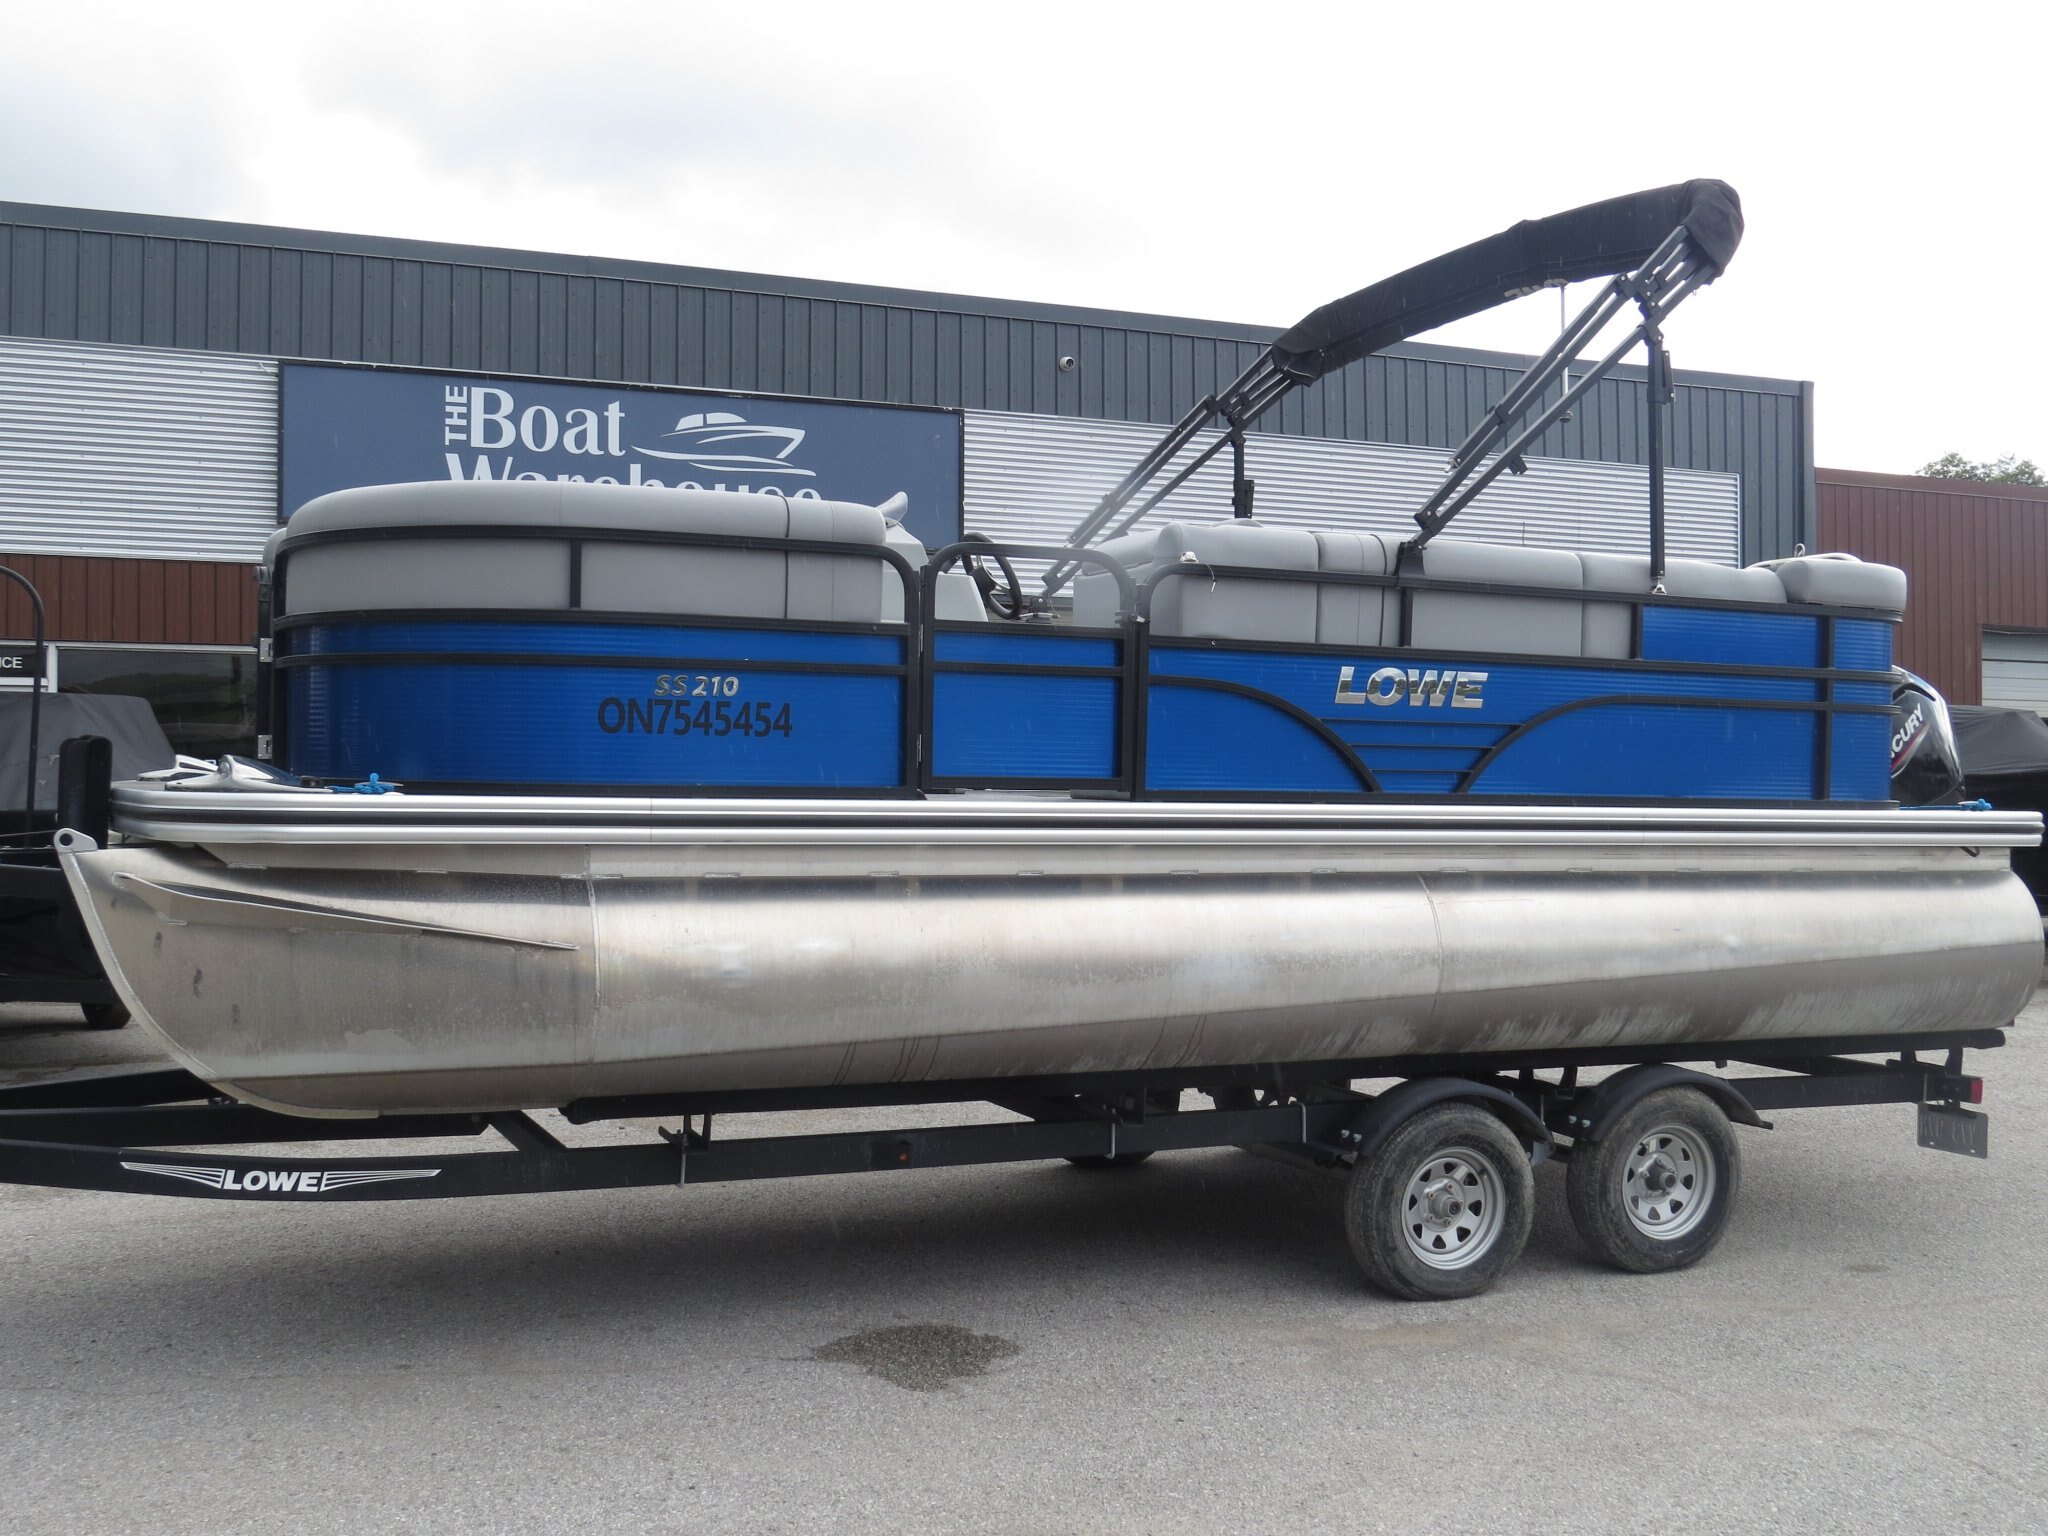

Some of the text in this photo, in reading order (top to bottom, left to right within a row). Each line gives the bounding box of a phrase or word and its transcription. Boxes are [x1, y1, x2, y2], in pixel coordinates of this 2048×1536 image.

[445, 385, 468, 445] THE
[471, 386, 626, 457] Boat
[654, 674, 739, 697] SS 210
[1335, 665, 1489, 709] LOWE
[598, 696, 793, 738] ON7545454
[1890, 702, 1924, 759] CURY
[222, 1168, 322, 1192] LOWE
